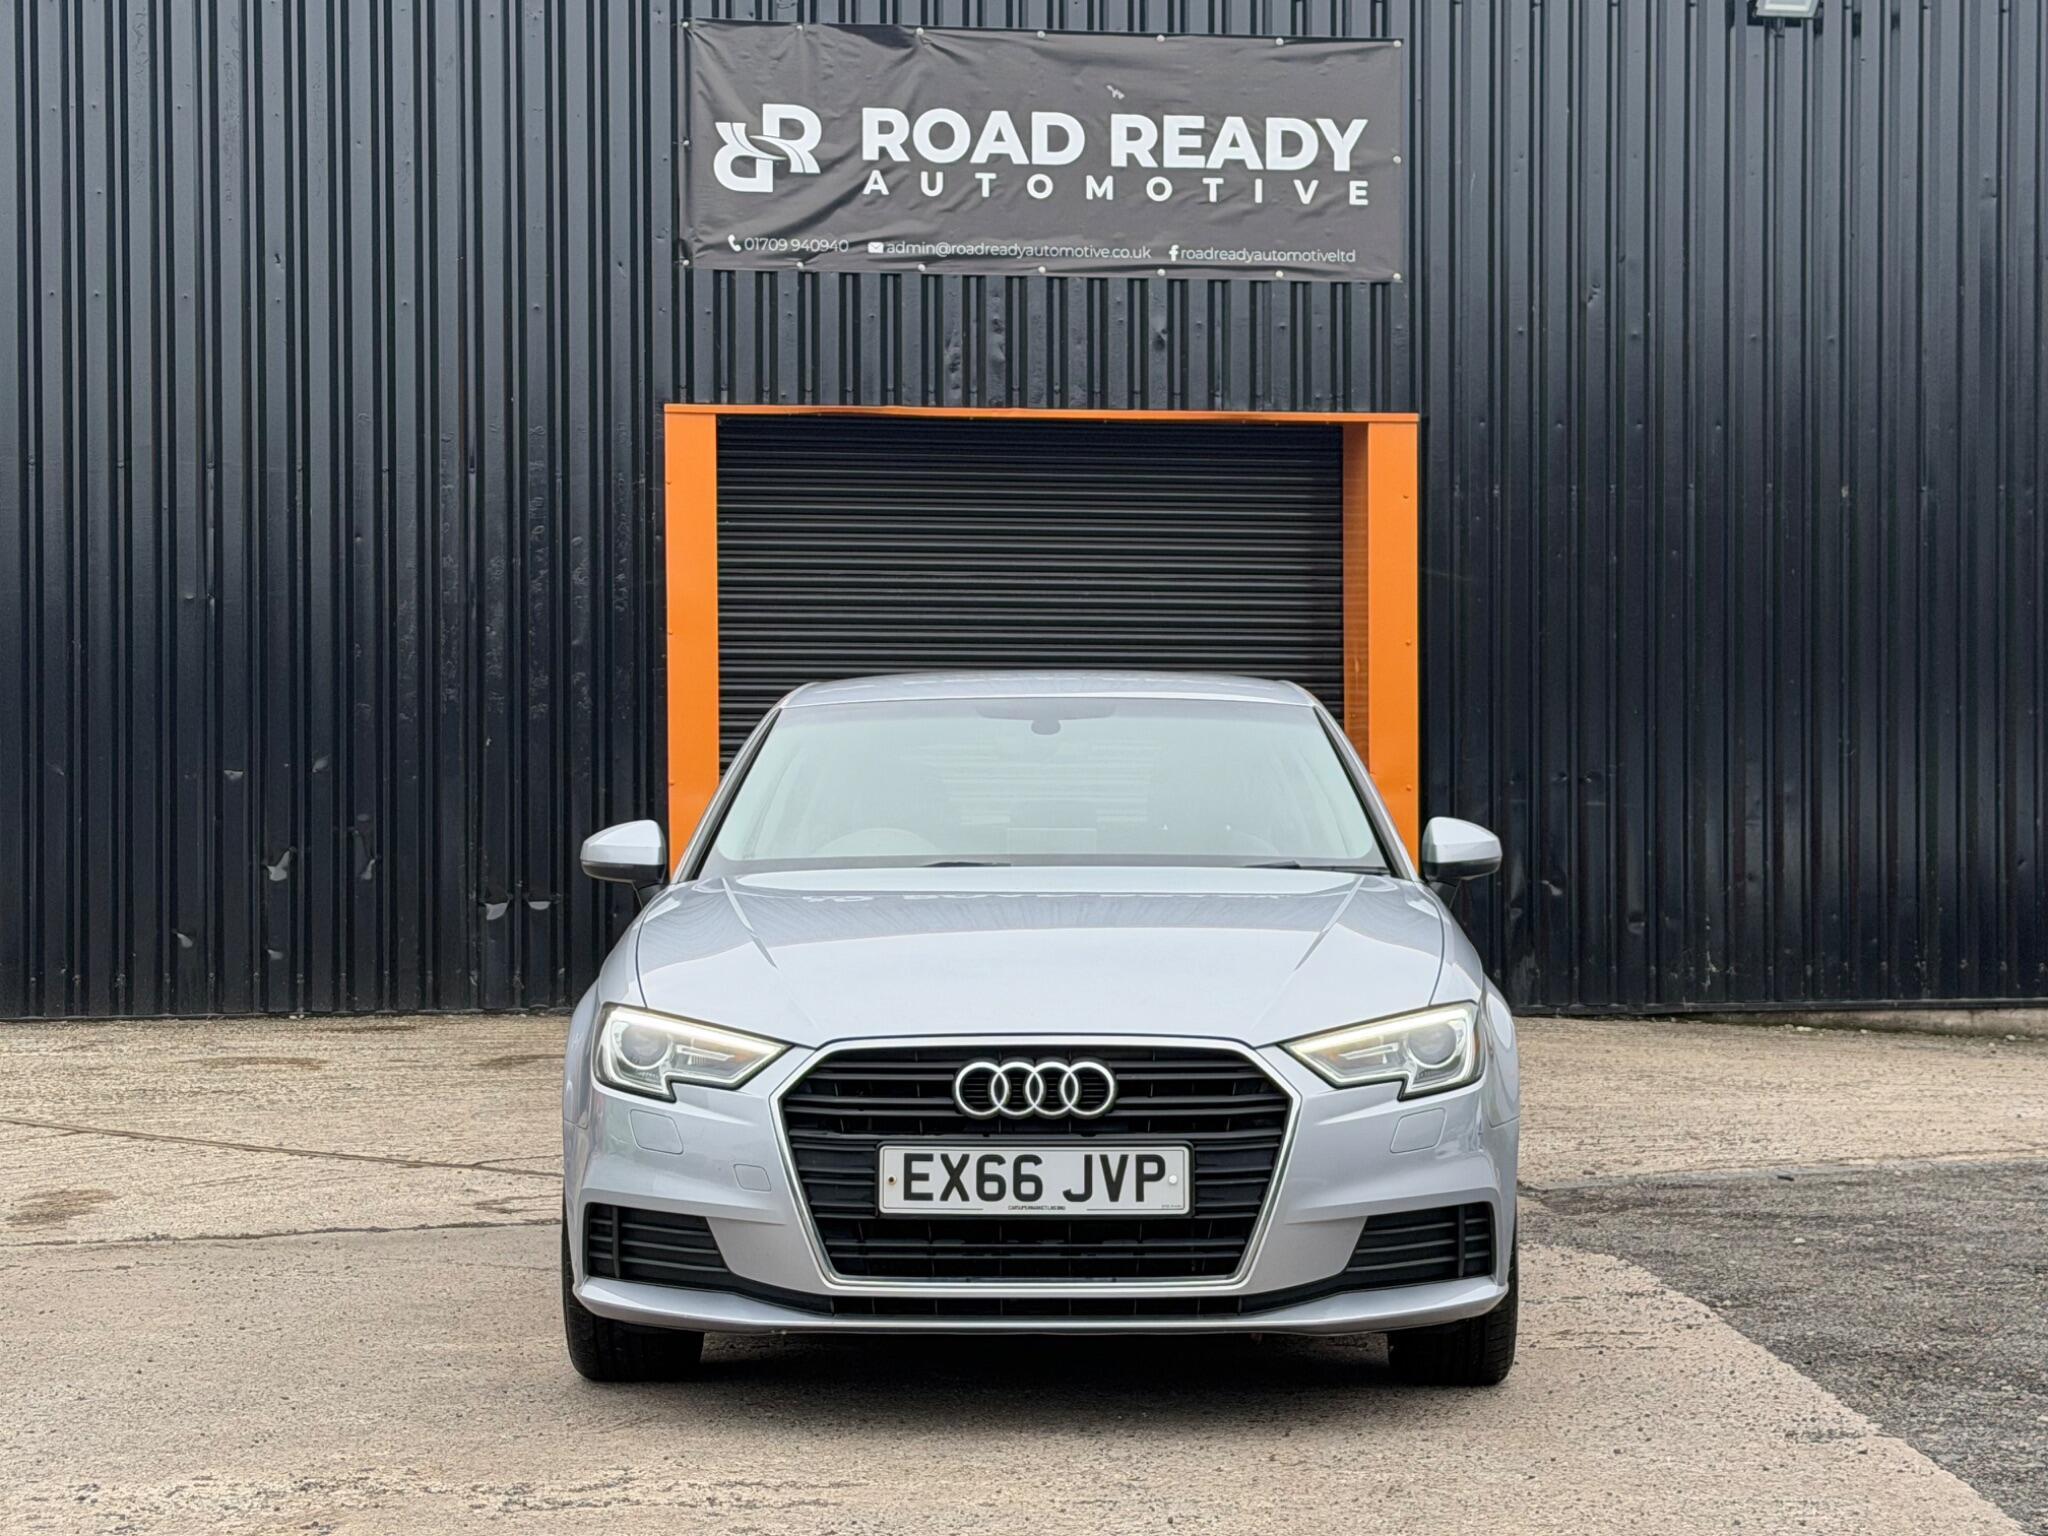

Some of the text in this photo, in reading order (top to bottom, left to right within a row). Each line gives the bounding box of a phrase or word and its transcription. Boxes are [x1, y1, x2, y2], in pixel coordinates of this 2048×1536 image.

[862, 107, 1369, 172] ROAD READY
[862, 169, 1369, 206] AUTOMOTIVE
[744, 236, 849, 253] 01709 940940
[886, 240, 1152, 260] admin@roadreadyautomotive.co.uk
[1180, 246, 1356, 263] roadreadyautomotiveltd
[903, 1153, 1166, 1203] EX66 JVP
